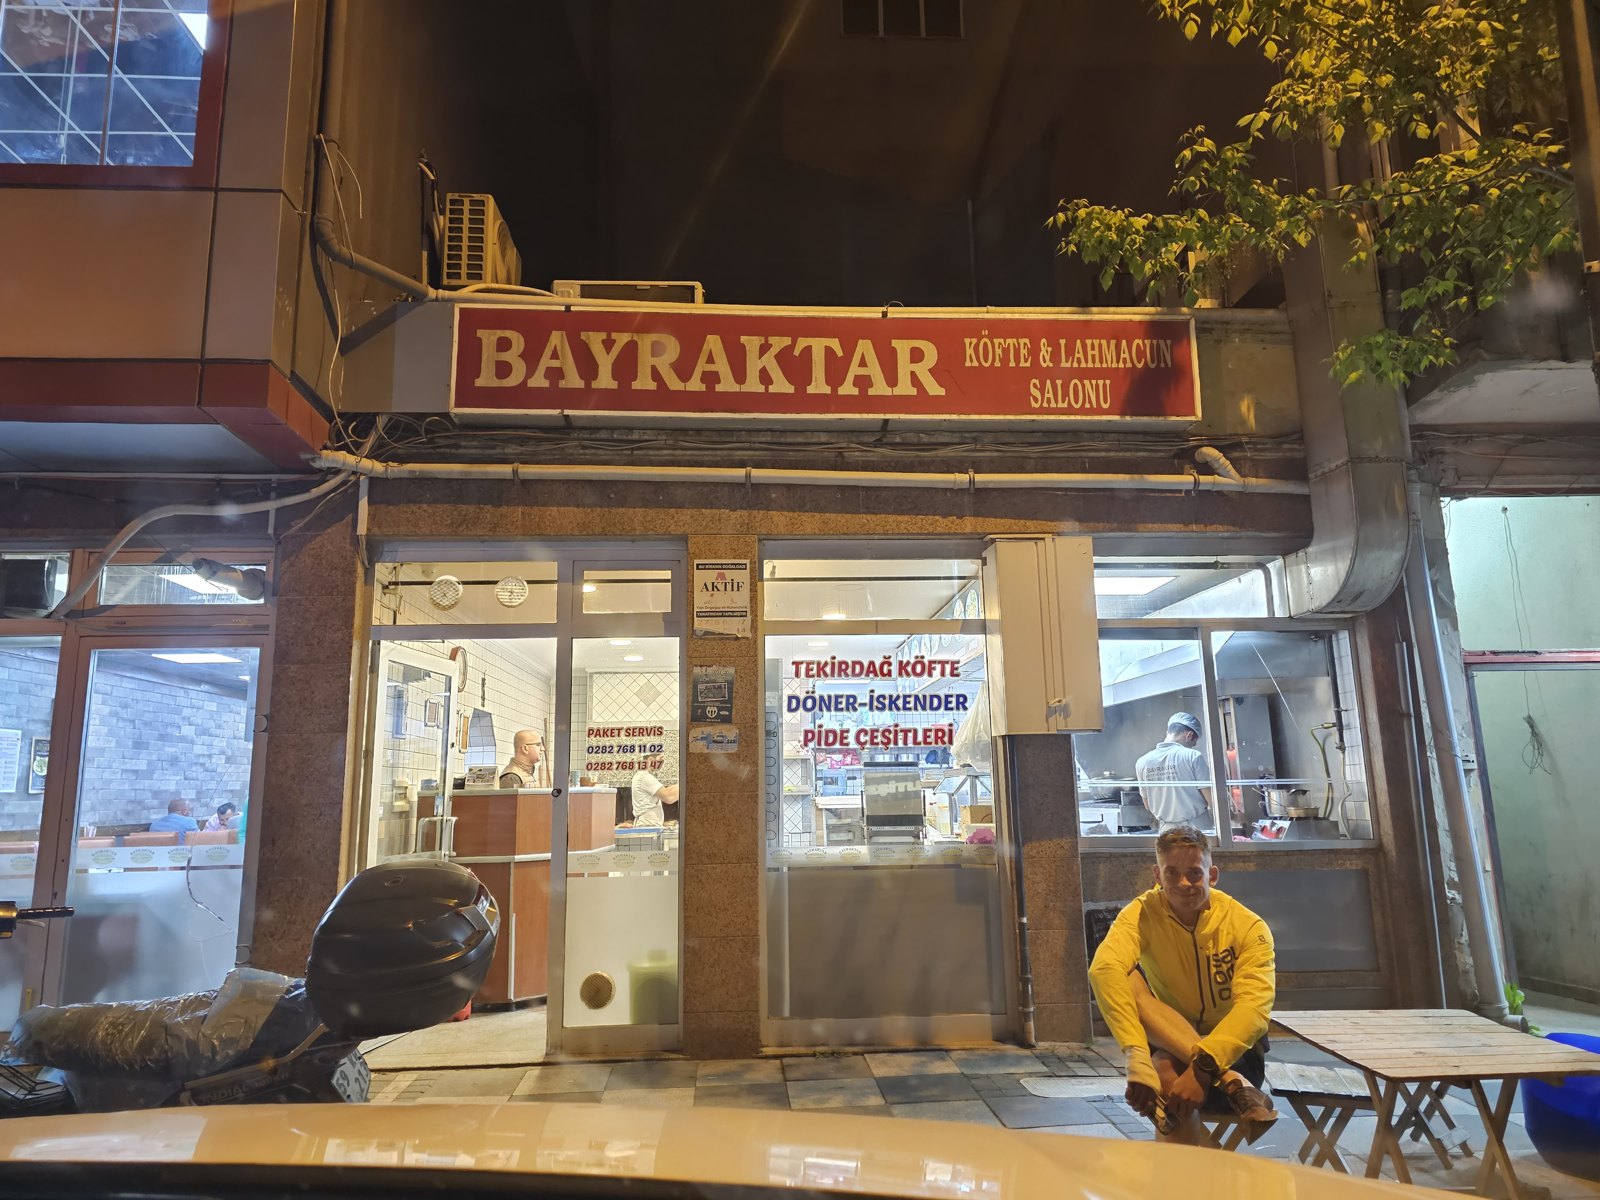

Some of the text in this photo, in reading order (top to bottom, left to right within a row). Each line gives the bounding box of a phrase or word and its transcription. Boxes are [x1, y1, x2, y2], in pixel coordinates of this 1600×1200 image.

[964, 329, 1172, 368] KÖFTE & LAHMACUN
[474, 329, 945, 396] BAYRAKTAR
[1030, 378, 1111, 408] SALONU
[700, 578, 745, 592] AKTİF
[792, 655, 961, 679] TEKİRDAĞ KÖFTE
[787, 689, 968, 713] DÖNER-İSKENDER
[587, 728, 622, 738] PAKET
[803, 722, 954, 750] PİDE ÇEŞİTLERİ
[587, 744, 664, 754] 0282 768 11 02
[586, 760, 664, 771] 0282 768 13 47
[336, 1069, 350, 1096] 59
